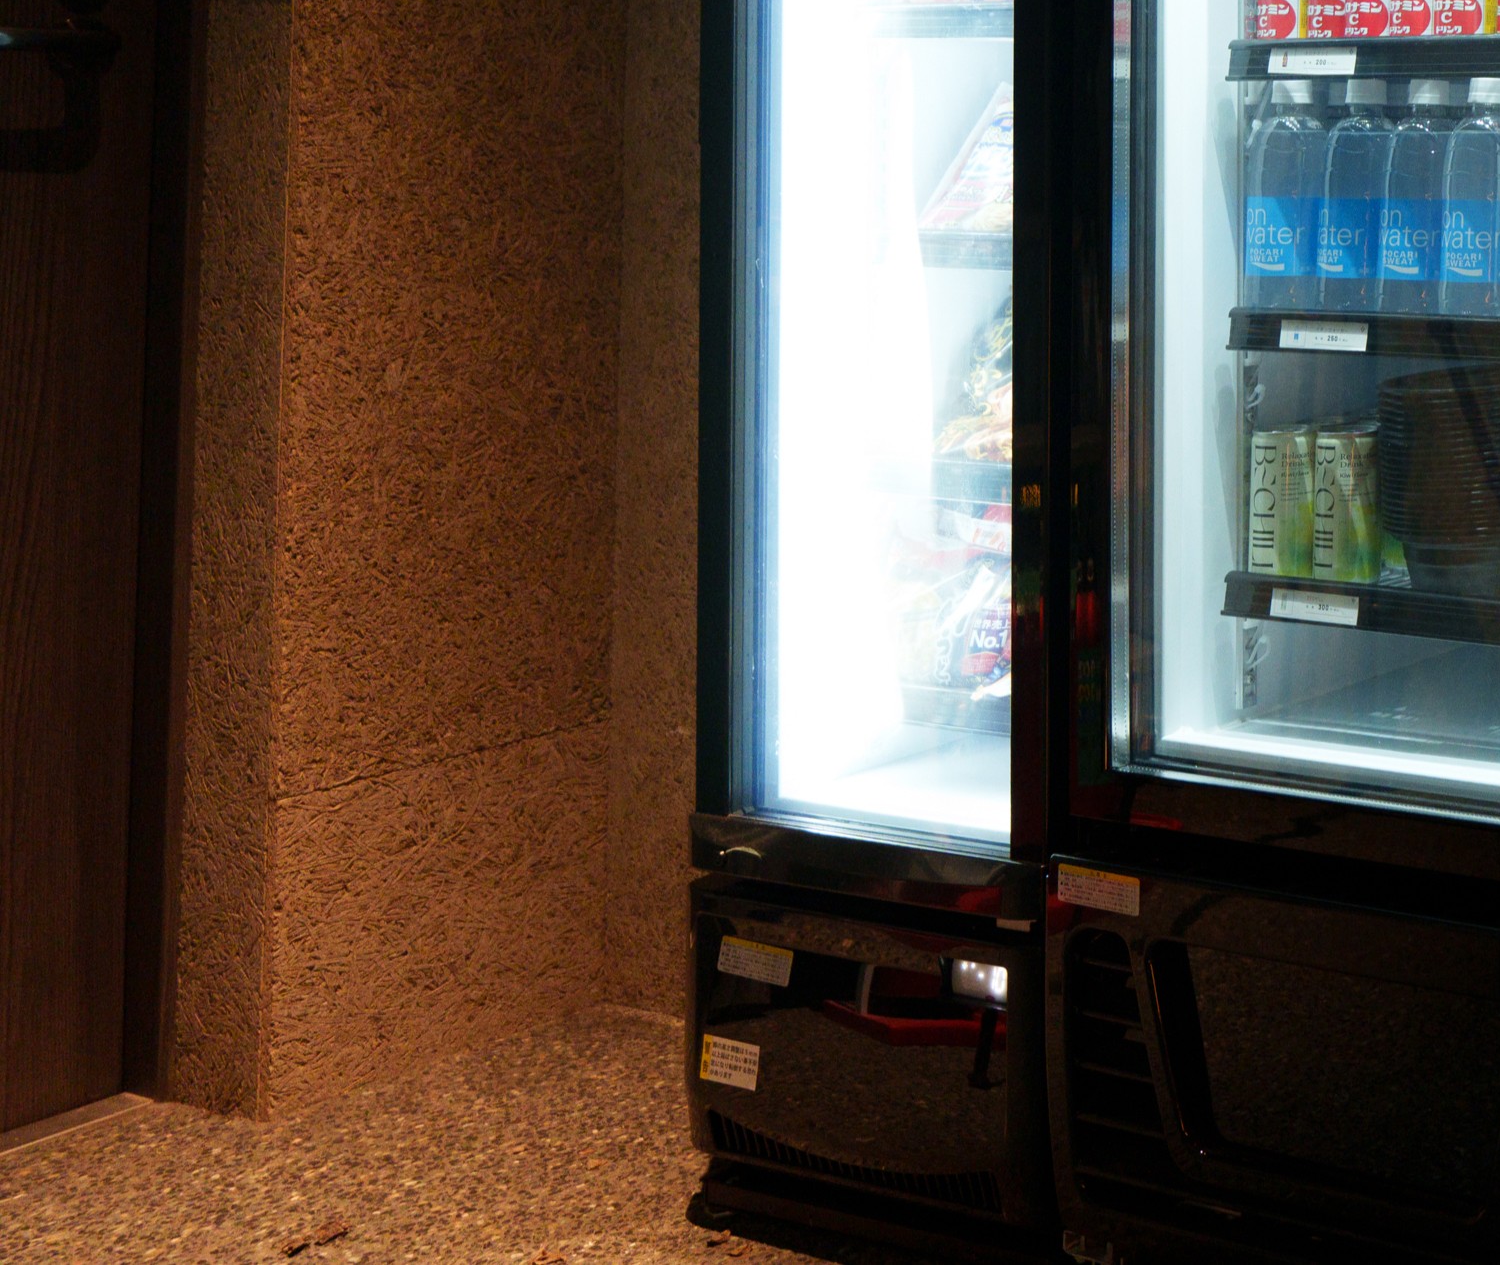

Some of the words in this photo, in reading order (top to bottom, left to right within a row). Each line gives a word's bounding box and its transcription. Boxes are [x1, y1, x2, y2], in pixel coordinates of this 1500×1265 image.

[1259, 16, 1268, 28] C
[1312, 17, 1323, 28] C
[1349, 14, 1359, 25] C
[1392, 13, 1402, 24] C
[1441, 12, 1452, 23] C
[1380, 209, 1402, 227] on
[1443, 210, 1464, 229] on
[1383, 250, 1418, 259] POCARI
[1446, 252, 1482, 261] POCARI
[1340, 460, 1363, 468] Drink
[970, 629, 1008, 648] No.1
